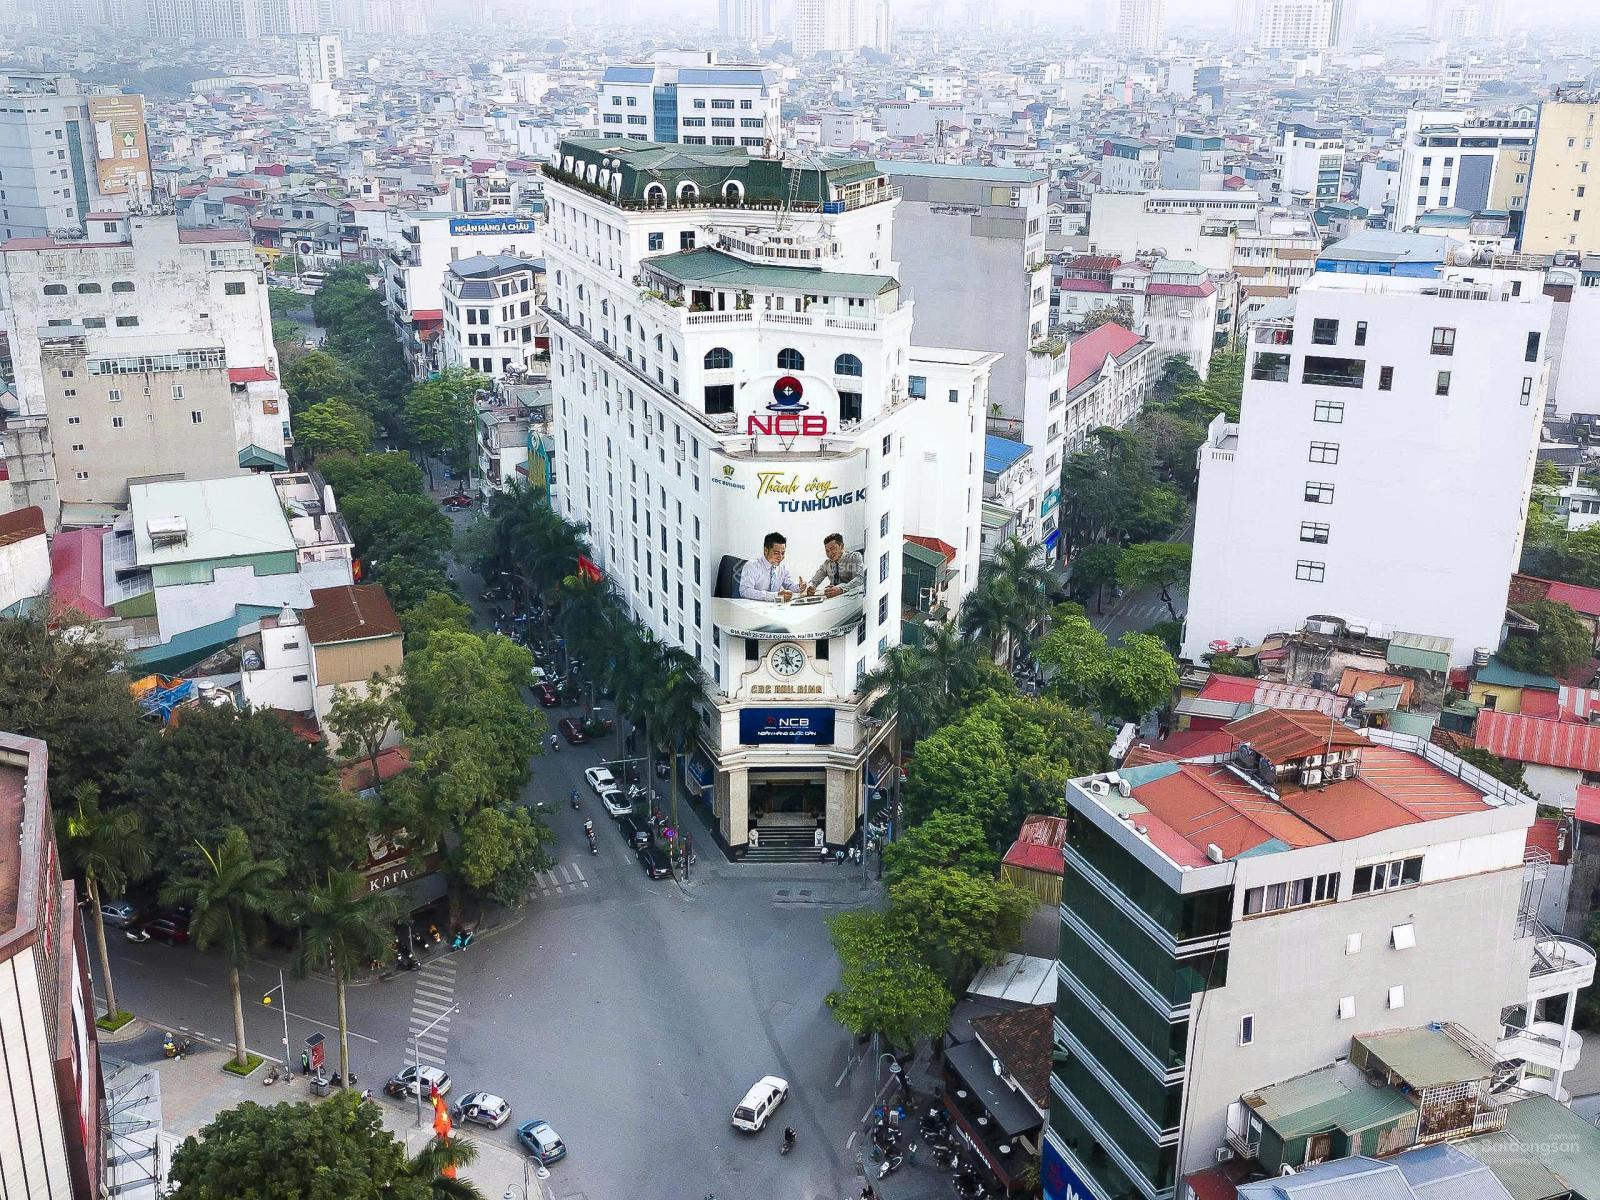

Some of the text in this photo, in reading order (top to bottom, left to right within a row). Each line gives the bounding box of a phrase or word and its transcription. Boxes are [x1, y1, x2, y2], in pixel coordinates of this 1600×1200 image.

[455, 223, 477, 232] NGÂN
[478, 223, 500, 232] HÀNG
[508, 222, 529, 231] CHÂU
[747, 415, 828, 436] NCB
[711, 477, 746, 490] CDC BUILDING
[757, 472, 838, 500] Thành công
[778, 498, 800, 513] TỪ
[779, 718, 810, 726] NCB
